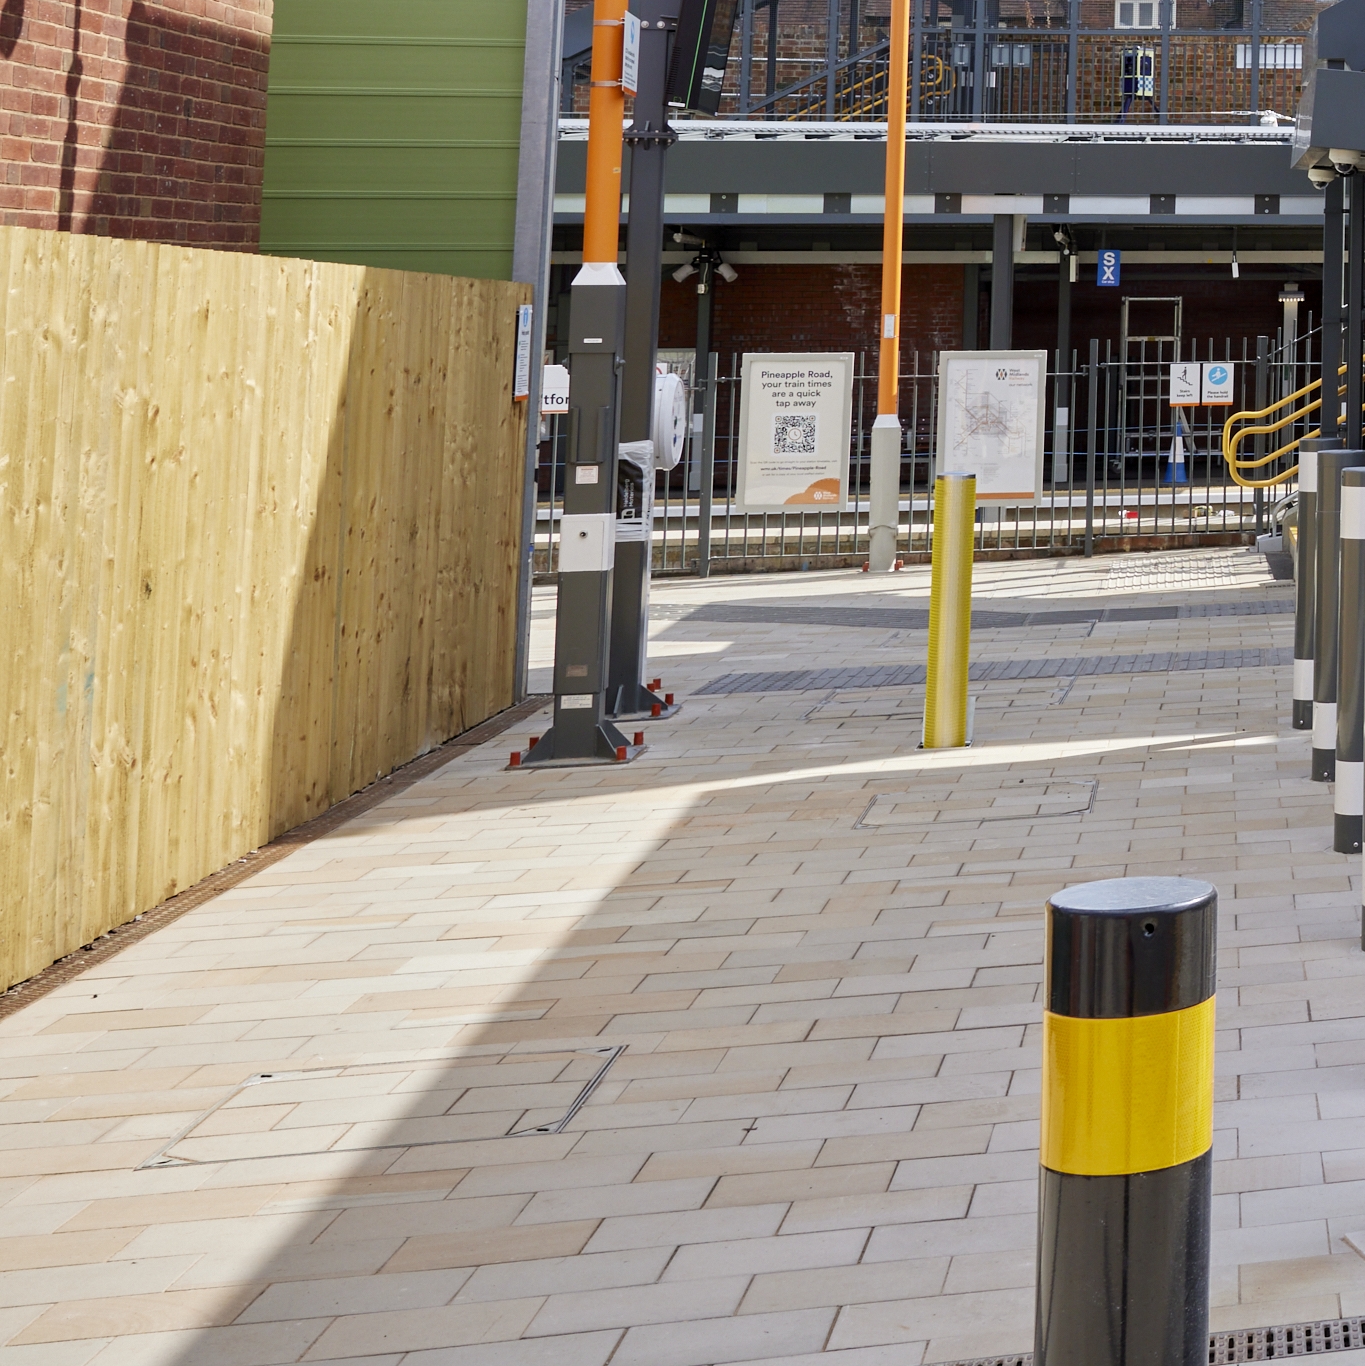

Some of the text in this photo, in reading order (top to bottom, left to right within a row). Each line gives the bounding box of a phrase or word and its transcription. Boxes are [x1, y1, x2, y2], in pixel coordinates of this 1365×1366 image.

[761, 370, 833, 380] Pineapple Road,
[762, 382, 782, 390] your
[784, 380, 805, 388] train
[544, 393, 570, 405] tfor
[796, 390, 821, 399] quick
[775, 400, 817, 408] tap away
